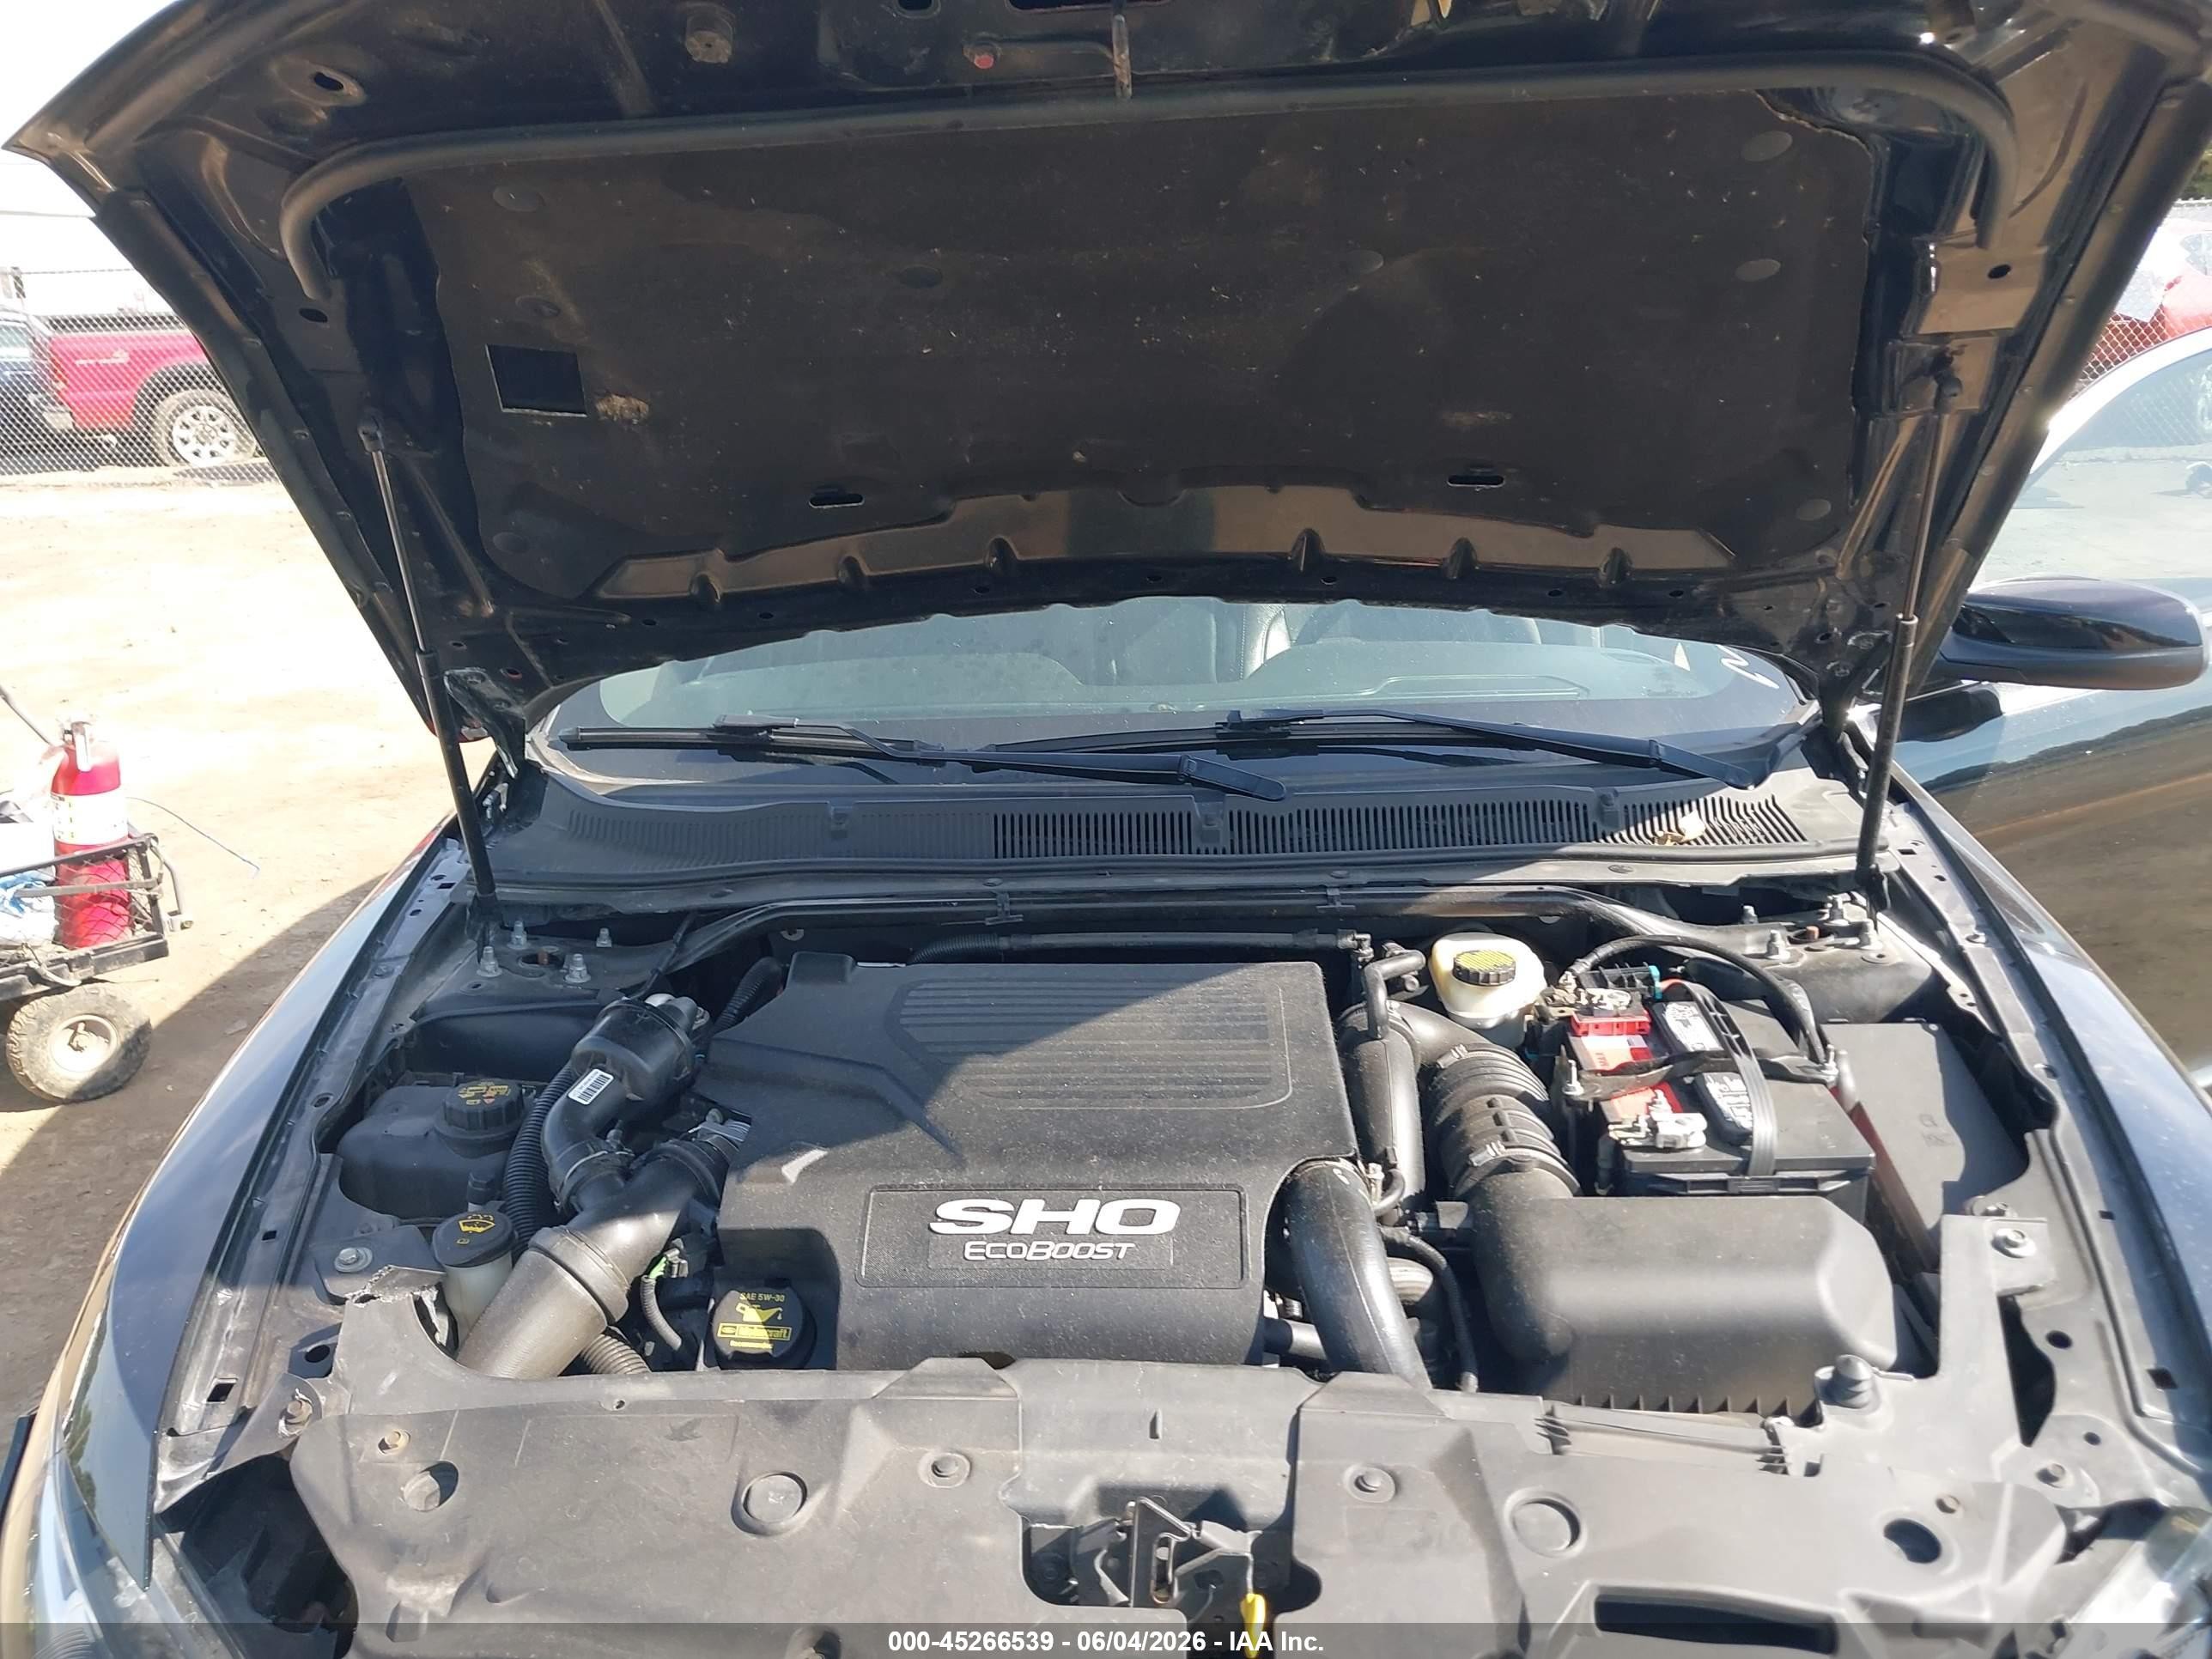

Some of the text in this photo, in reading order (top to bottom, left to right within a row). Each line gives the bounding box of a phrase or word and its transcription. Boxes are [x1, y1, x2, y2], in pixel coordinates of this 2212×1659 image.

[929, 1199, 1181, 1235] SHO
[739, 1292, 785, 1303] SAE 5W-30
